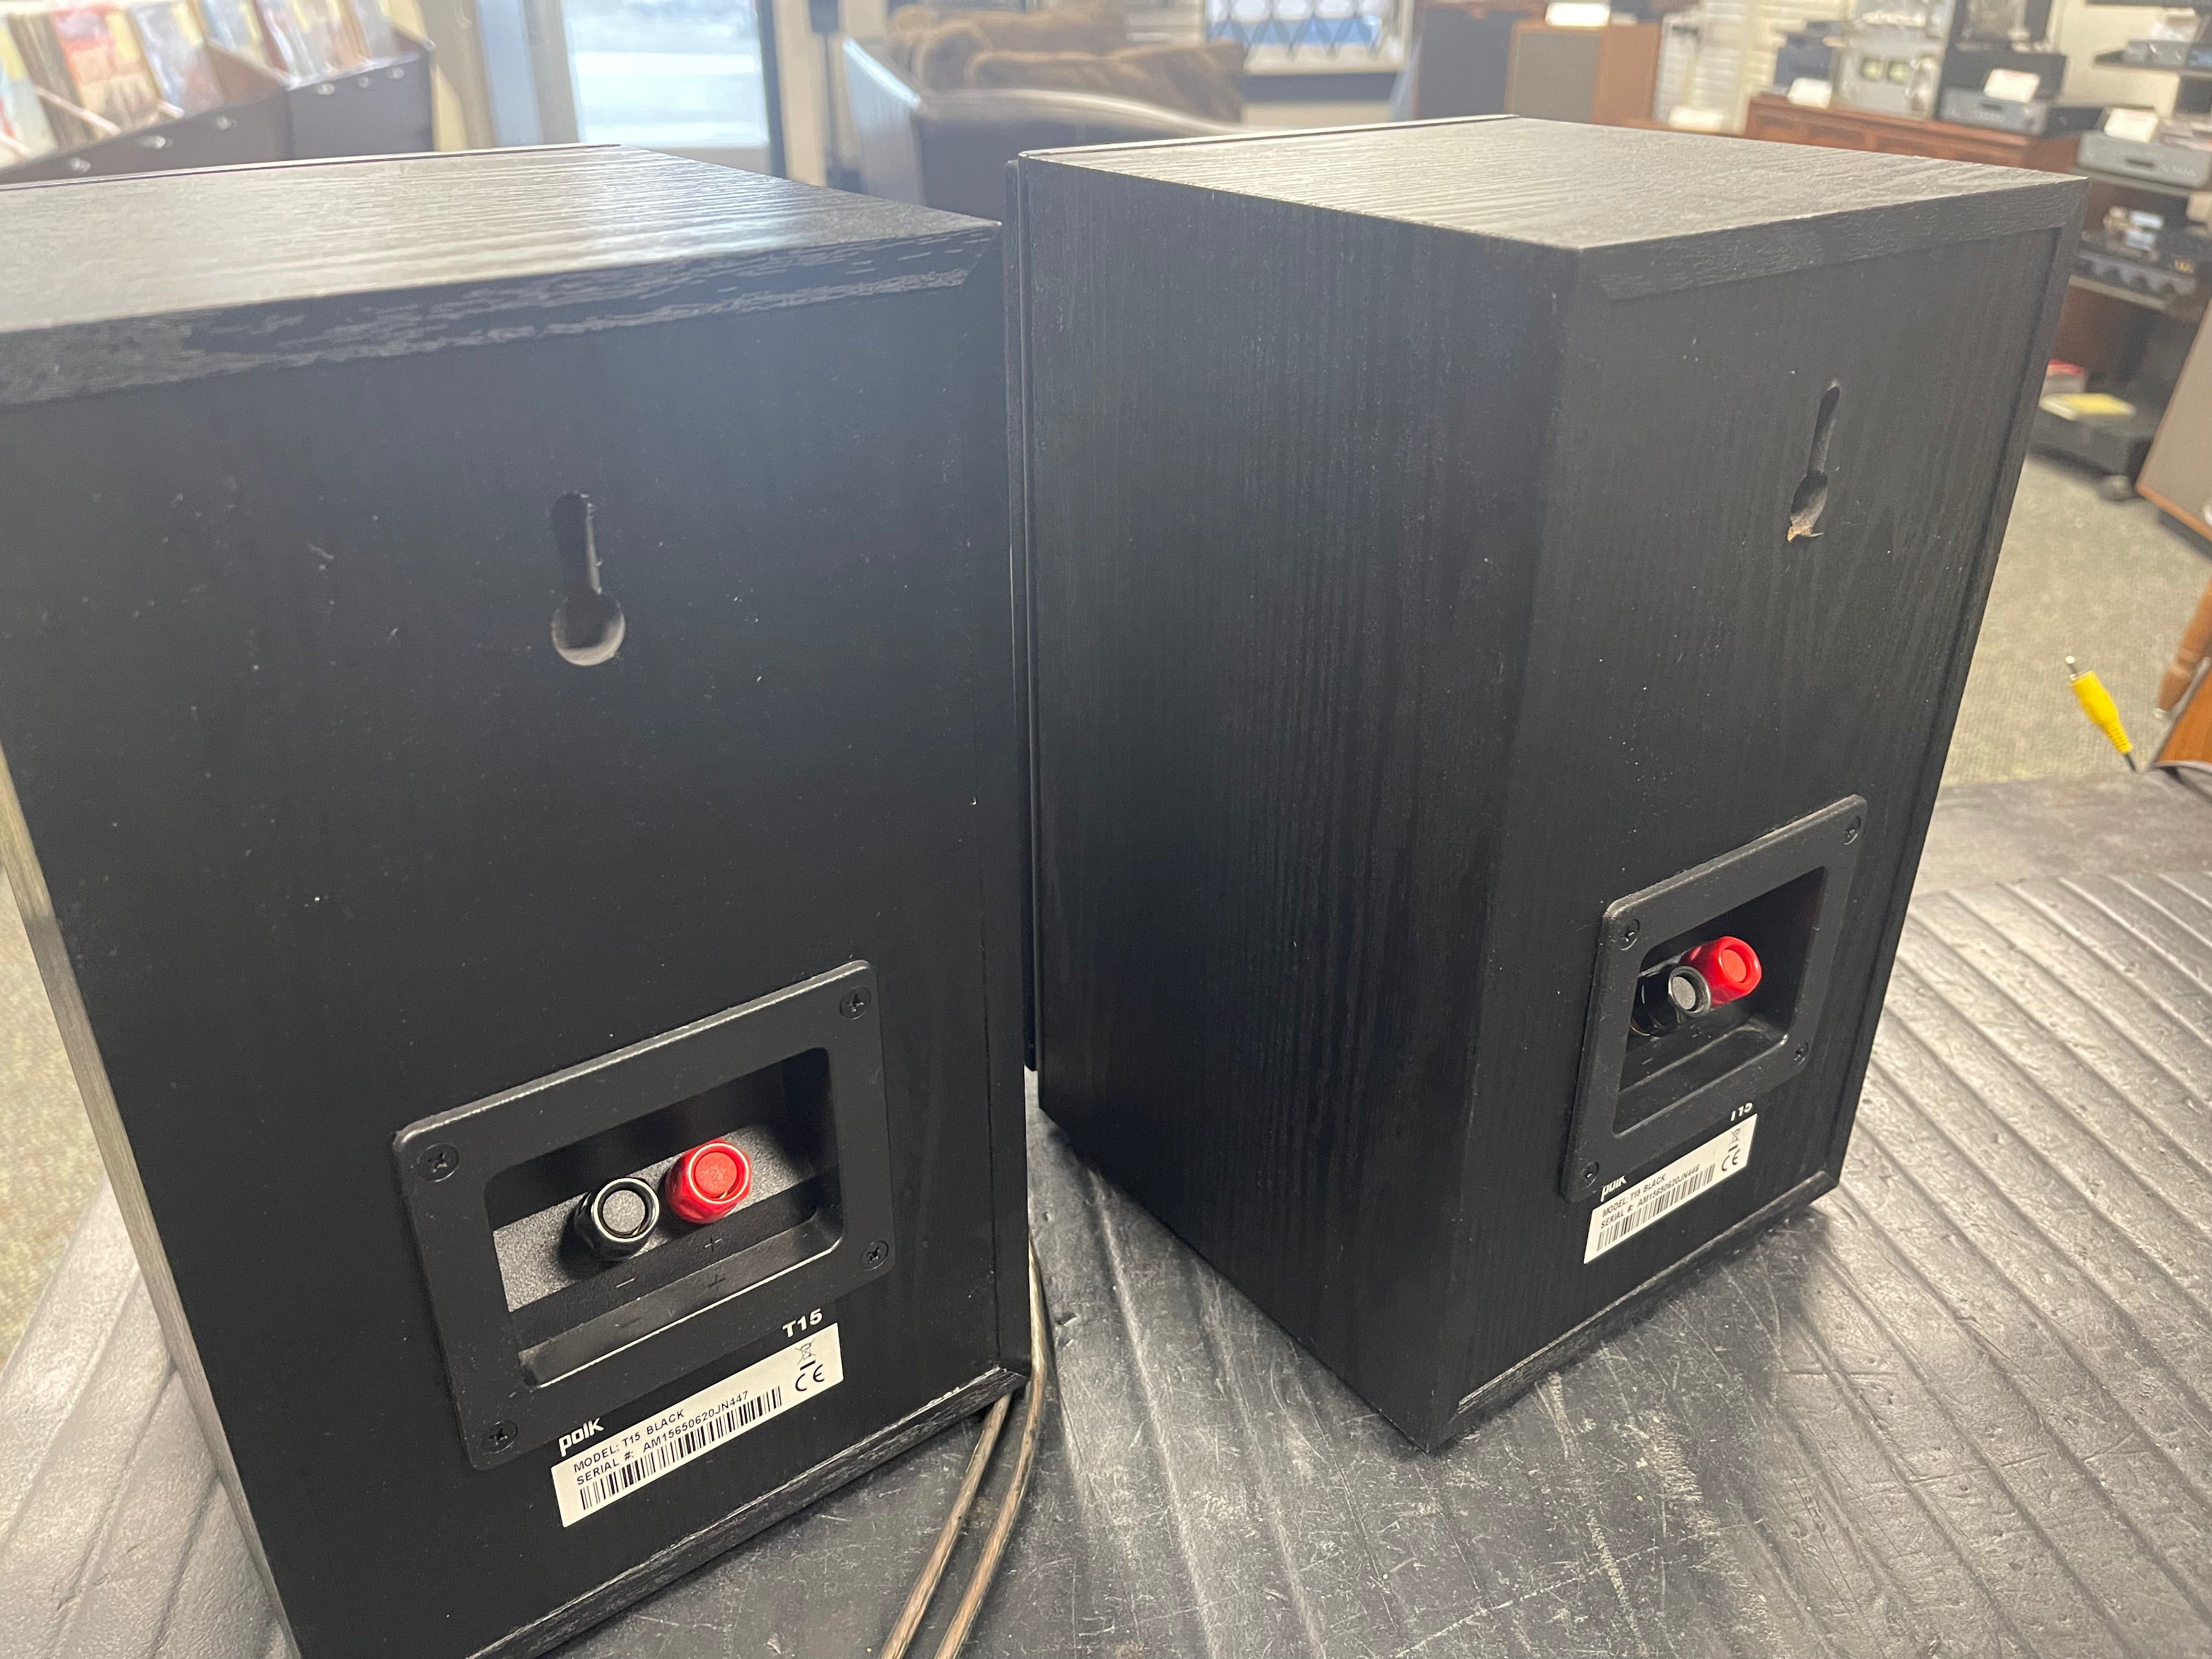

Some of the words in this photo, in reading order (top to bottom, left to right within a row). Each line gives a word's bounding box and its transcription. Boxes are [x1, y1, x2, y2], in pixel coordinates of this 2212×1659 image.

[1721, 1148, 1741, 1172] CE
[1602, 1197, 1629, 1218] MODEL:
[1630, 1188, 1641, 1200] T15
[1643, 1173, 1667, 1193] BLACK
[1600, 1209, 1624, 1229] SERIAL
[782, 1308, 822, 1338] T15
[795, 1364, 825, 1392] CE
[558, 1417, 605, 1458] polk
[573, 1444, 620, 1473] MODEL:
[622, 1431, 641, 1447] T15
[646, 1408, 685, 1435] BLACK
[577, 1458, 619, 1485] SERIAL
[624, 1451, 634, 1461] #:
[643, 1390, 748, 1453] AM15650620JN447
